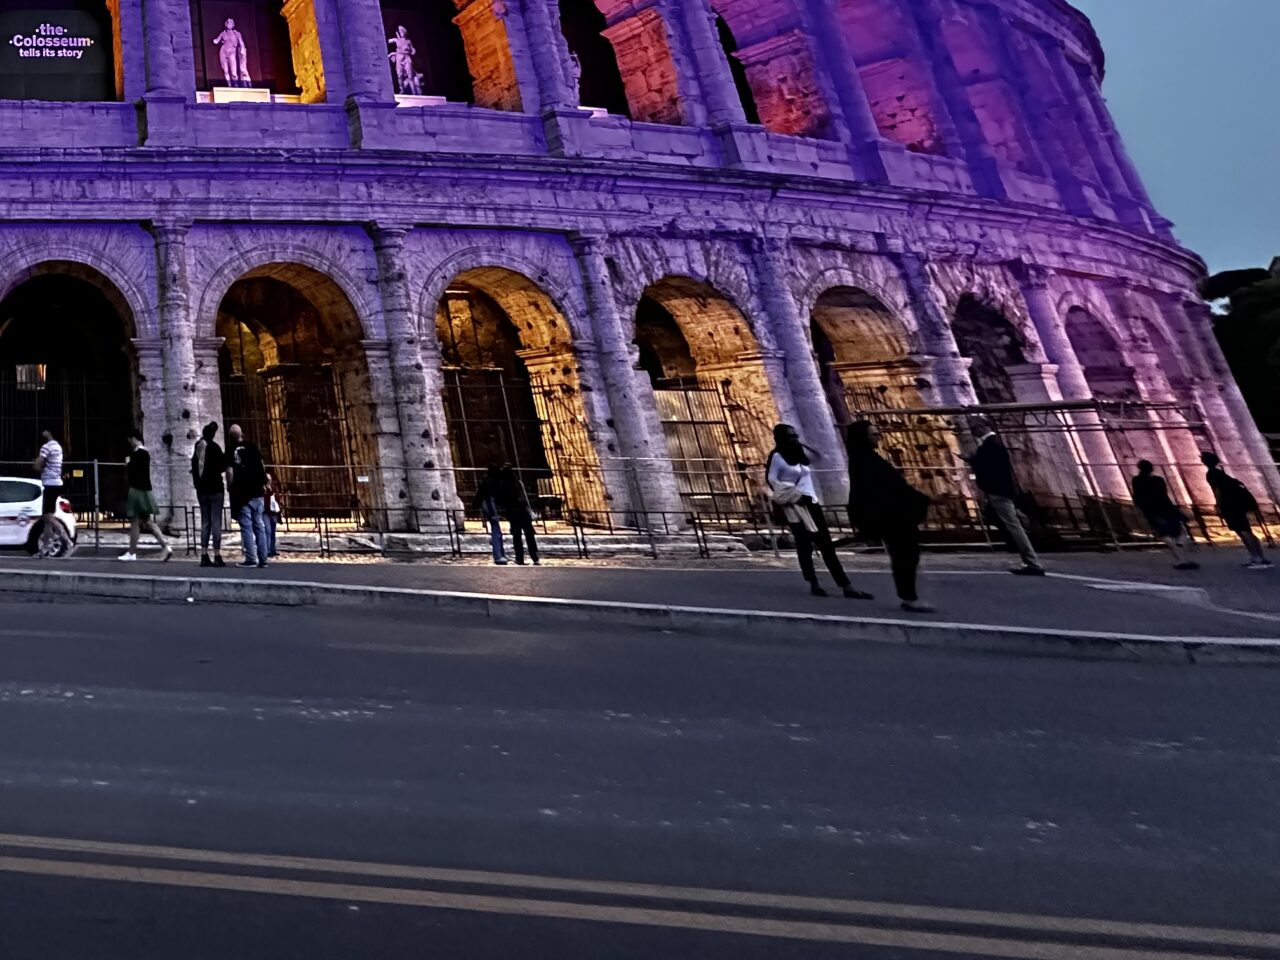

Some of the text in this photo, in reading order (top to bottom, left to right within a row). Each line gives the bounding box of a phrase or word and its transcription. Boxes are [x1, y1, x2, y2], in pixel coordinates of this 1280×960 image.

[40, 24, 63, 35] the
[13, 35, 90, 46] Colosseum
[19, 48, 83, 59] tells its story
